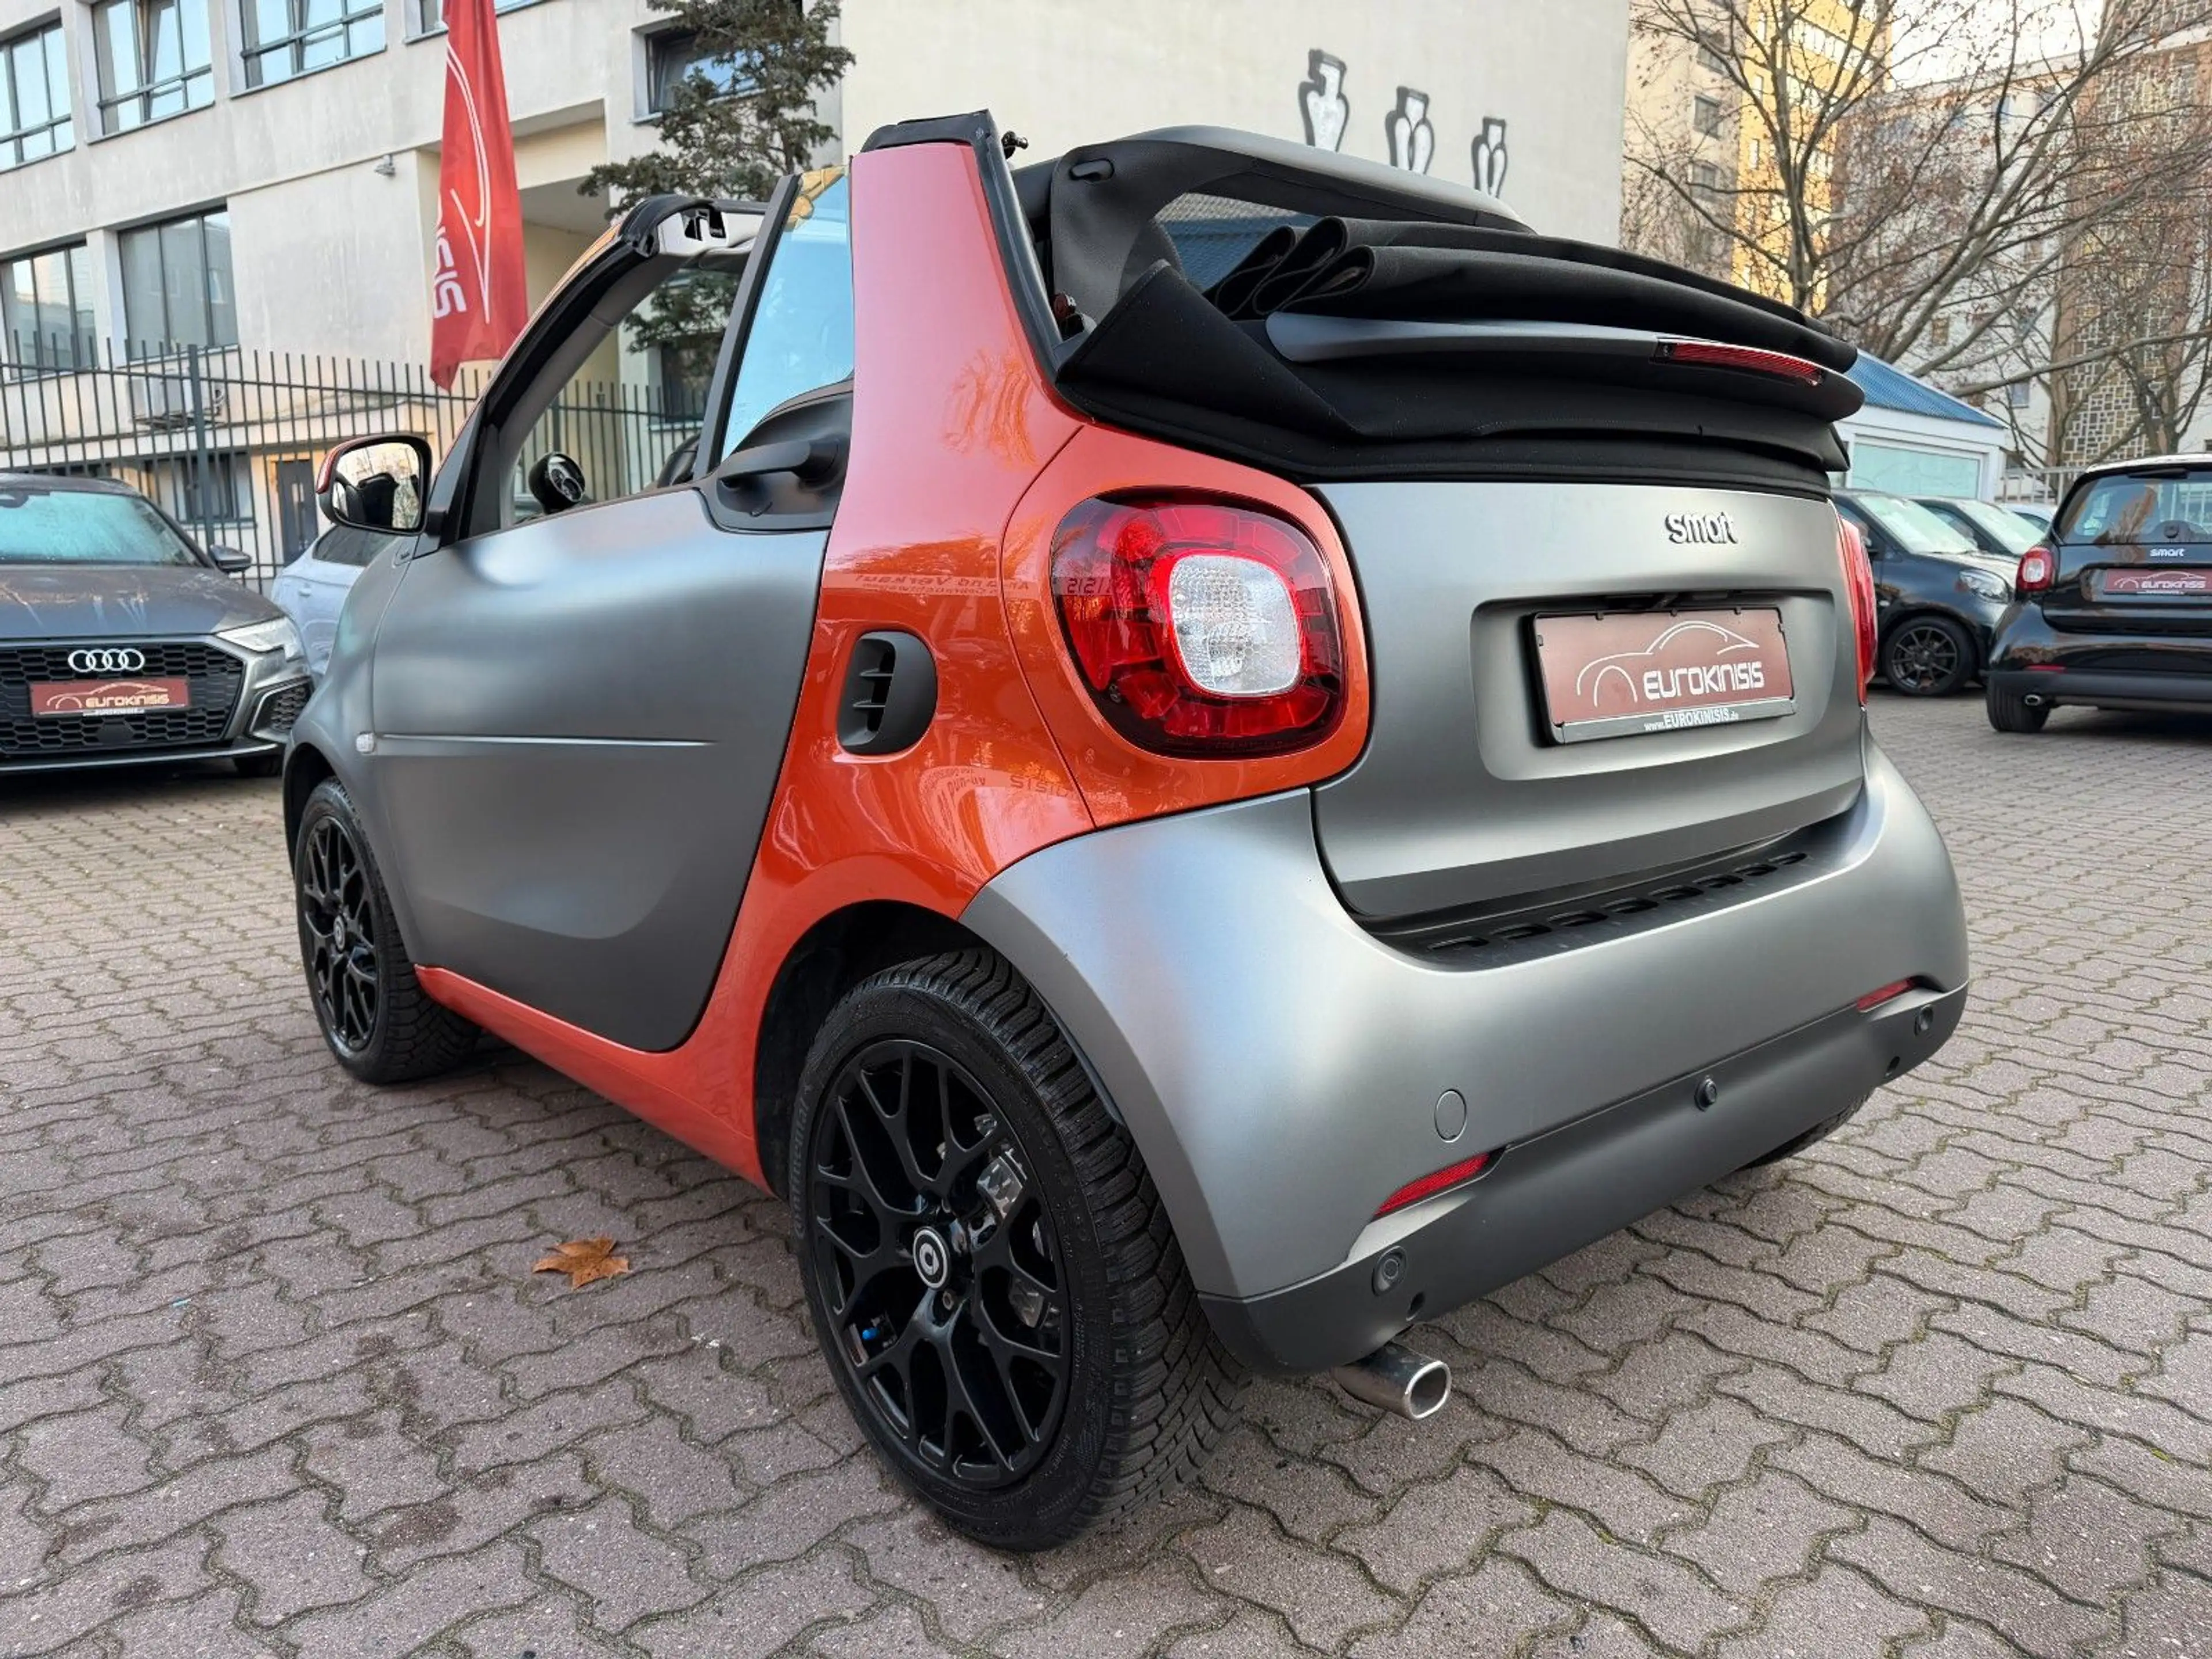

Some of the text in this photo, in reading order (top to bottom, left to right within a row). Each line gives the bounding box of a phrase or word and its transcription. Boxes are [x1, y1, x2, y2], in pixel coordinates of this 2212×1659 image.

[1667, 512, 1737, 544] smart
[2149, 548, 2185, 557] smart
[1643, 661, 1765, 700] EUROKINISIS
[1644, 708, 1739, 730] www.EUROKINISIS.de
